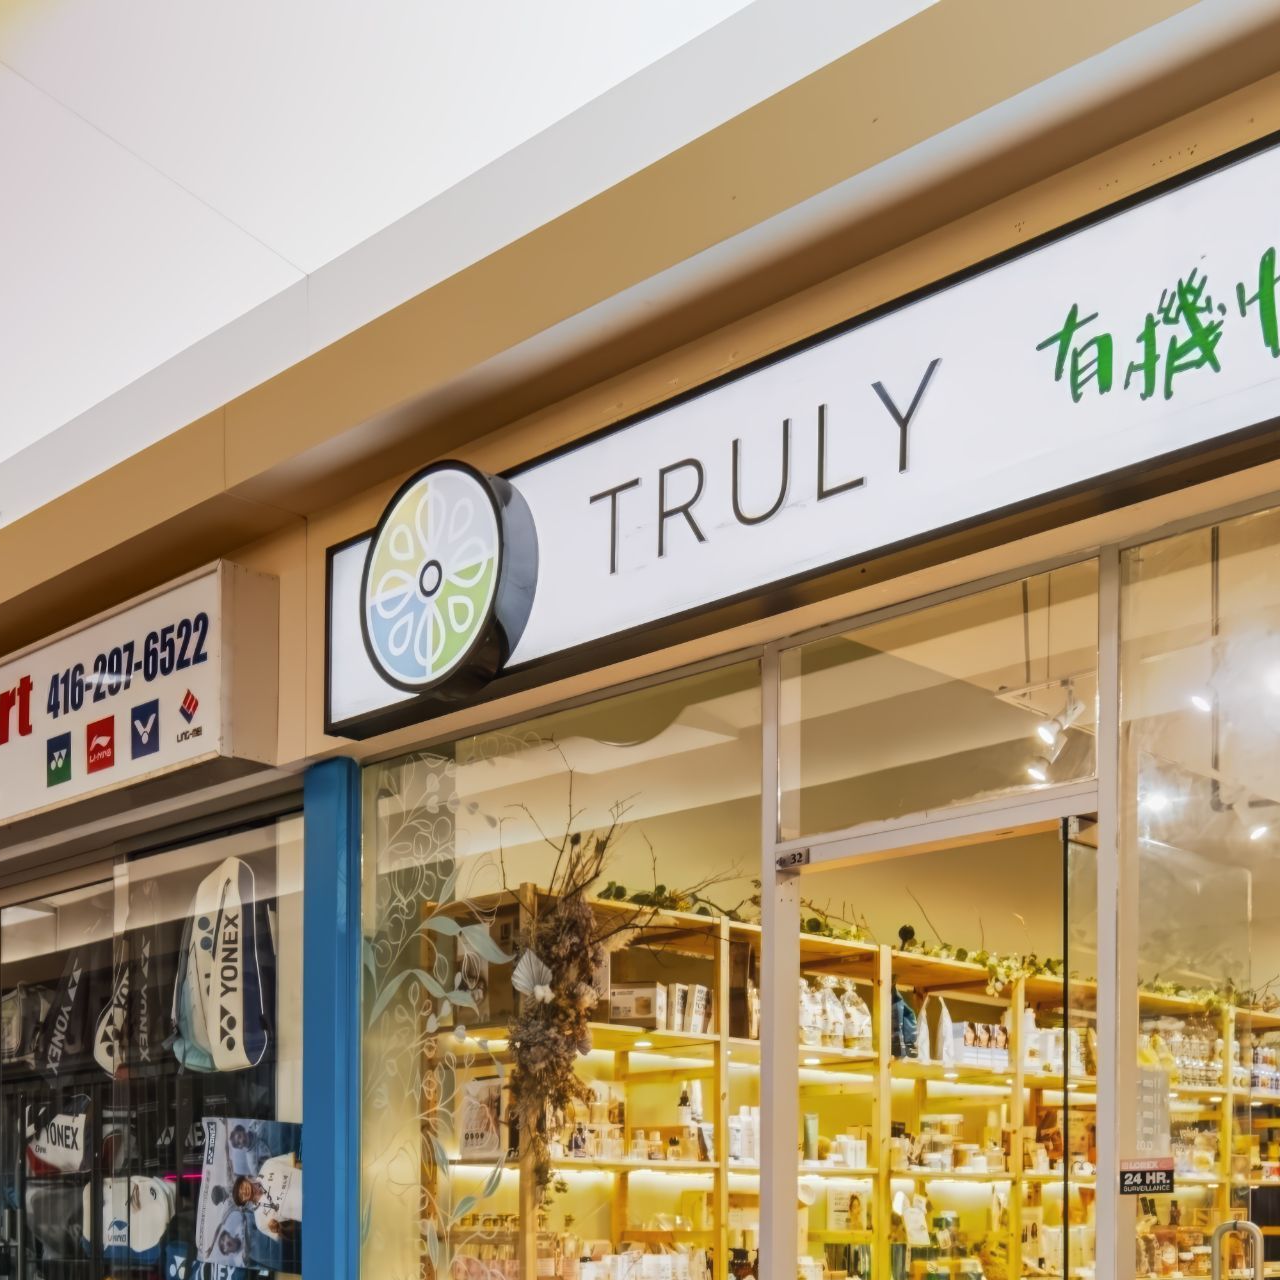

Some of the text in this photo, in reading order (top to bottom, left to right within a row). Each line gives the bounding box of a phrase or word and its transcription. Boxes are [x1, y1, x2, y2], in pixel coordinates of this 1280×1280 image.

[589, 358, 942, 575] TRULY
[46, 611, 209, 720] 416-297-6522
[220, 913, 239, 999] YONEX
[46, 1004, 72, 1076] YONEX
[138, 984, 152, 1063] YONEX
[46, 1121, 79, 1151] YONEX
[1123, 1172, 1170, 1185] 24 HR.
[1123, 1184, 1171, 1192] SURVEILLANCE
